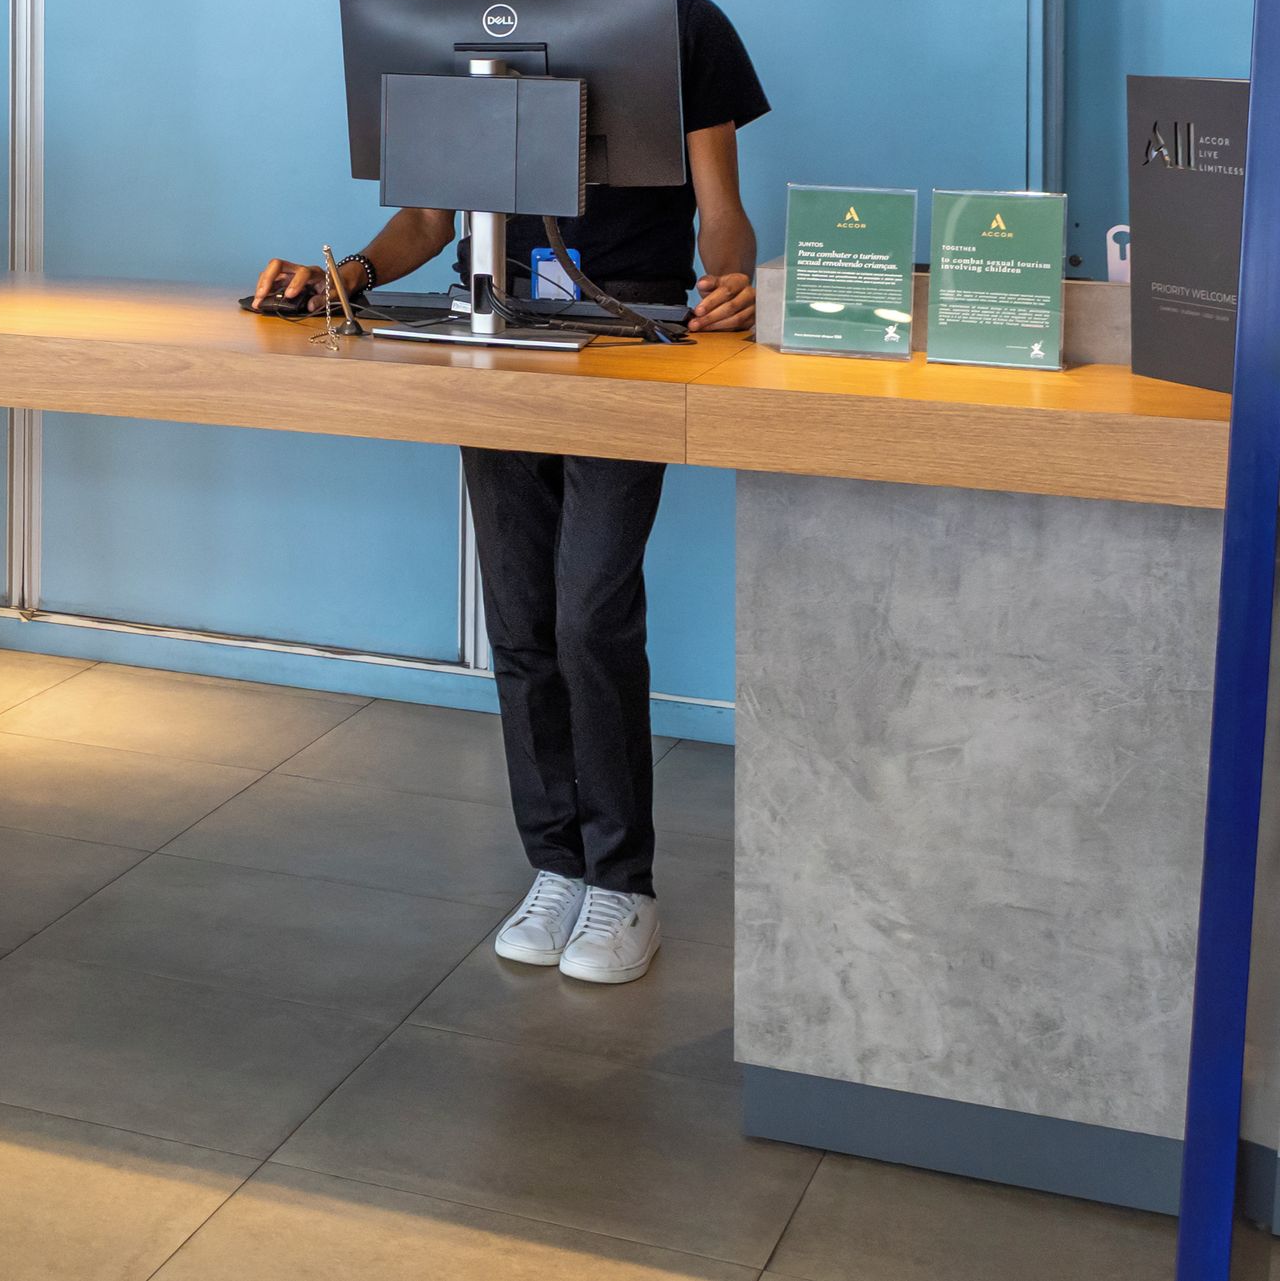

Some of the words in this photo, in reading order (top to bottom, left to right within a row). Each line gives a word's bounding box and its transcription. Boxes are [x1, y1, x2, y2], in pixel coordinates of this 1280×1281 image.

[487, 15, 514, 25] DELL
[1199, 136, 1230, 146] ACCOR
[1199, 150, 1219, 159] LIVE
[1199, 164, 1244, 176] LIMITLESS
[816, 250, 852, 259] combater
[859, 252, 889, 260] turismo
[797, 258, 821, 266] sexual
[822, 259, 863, 268] envolvendo
[952, 257, 984, 265] combat
[986, 259, 1014, 267] sexual
[1017, 261, 1051, 269] tourism
[941, 263, 982, 273] involving
[985, 265, 1021, 274] children
[1152, 282, 1191, 296] PRIORITY
[1191, 288, 1237, 305] WELCOME
